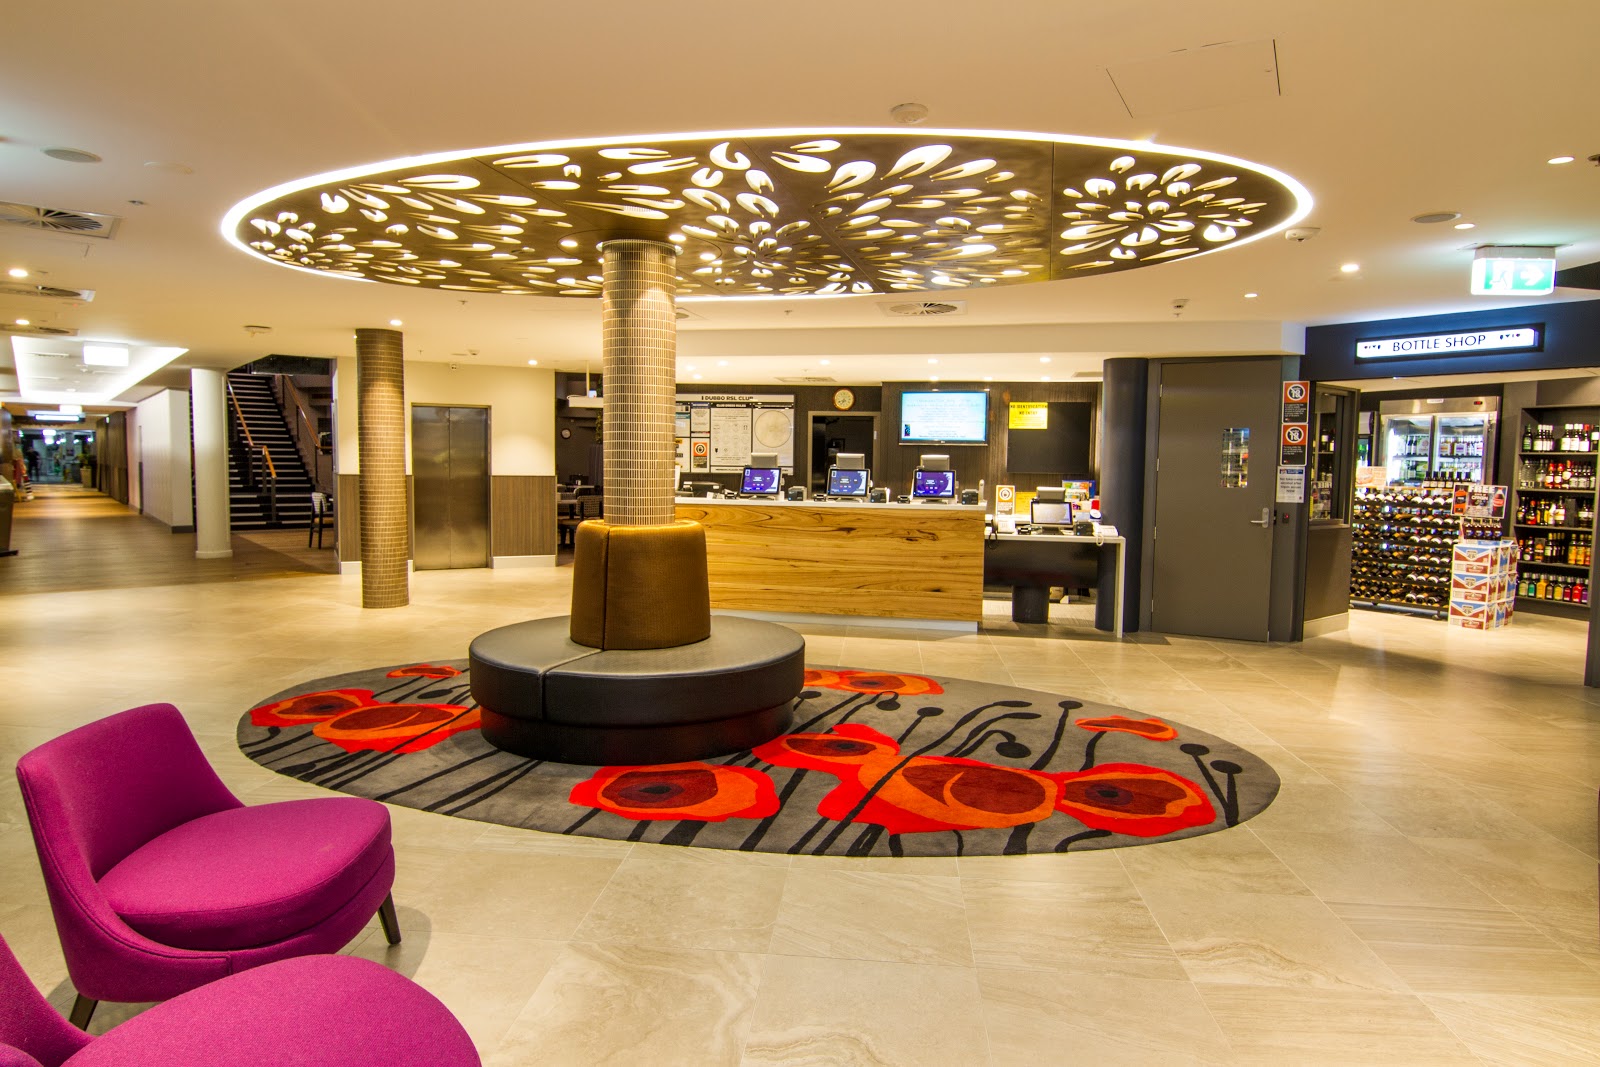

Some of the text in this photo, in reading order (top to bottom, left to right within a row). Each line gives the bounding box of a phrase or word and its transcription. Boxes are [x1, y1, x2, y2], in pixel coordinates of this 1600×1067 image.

[1393, 334, 1486, 352] BOTTLE SHOP
[1468, 485, 1495, 493] FREE
